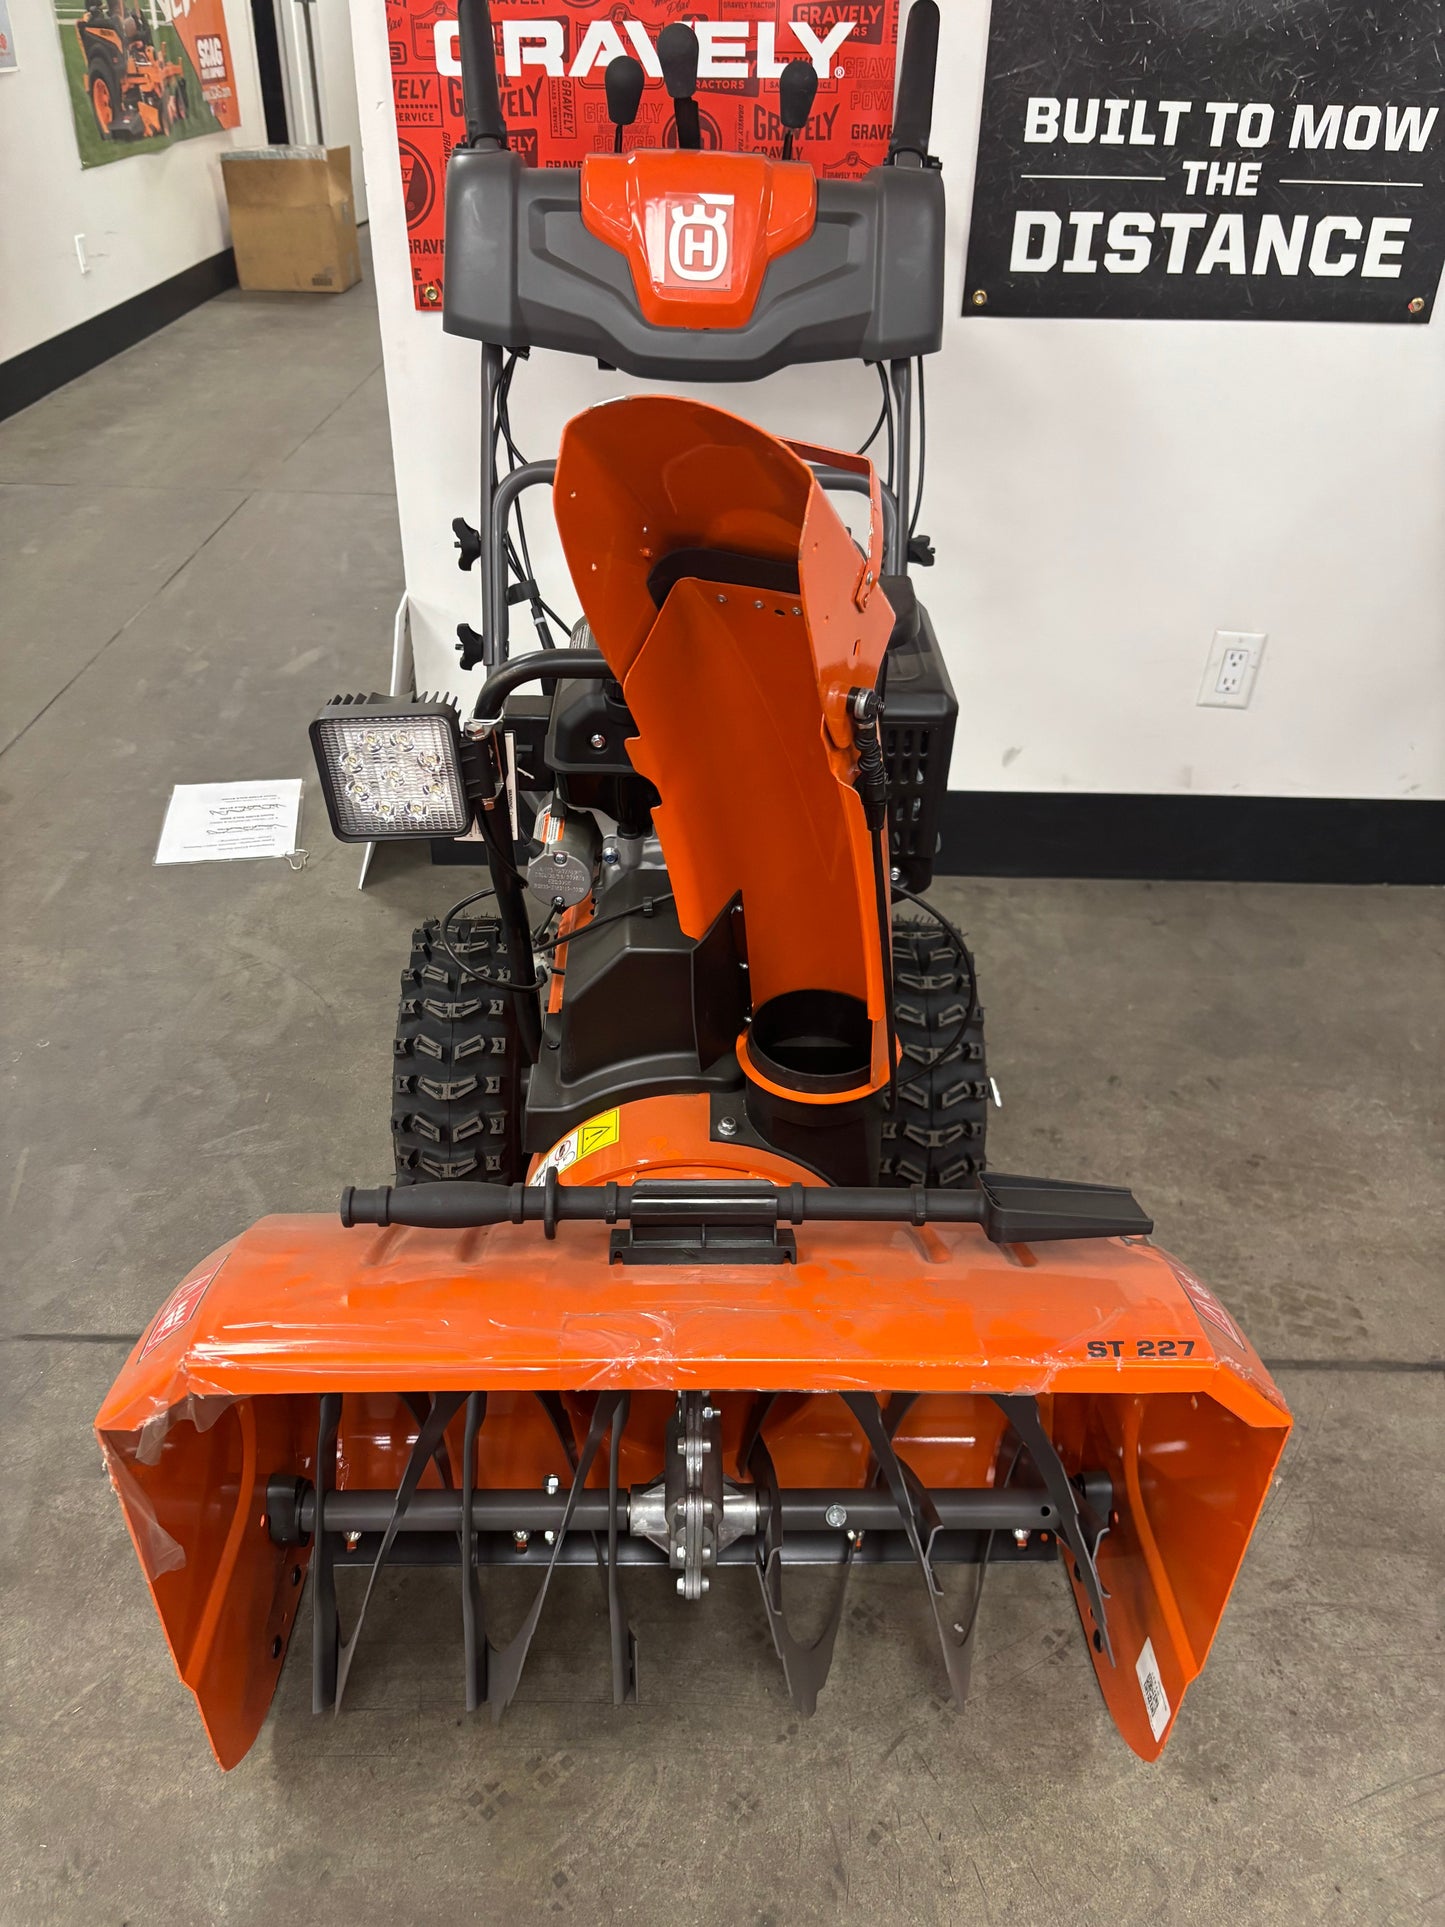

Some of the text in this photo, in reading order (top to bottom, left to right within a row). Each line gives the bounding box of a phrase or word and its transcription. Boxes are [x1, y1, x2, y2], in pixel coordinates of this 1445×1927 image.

[797, 5, 882, 25] GRAVELY
[696, 80, 745, 89] RACTORS
[562, 80, 574, 133] GRAVELY
[754, 104, 840, 141] GRELY
[1023, 97, 1439, 152] BUILT TO MOW
[1182, 161, 1262, 196] THE
[1010, 210, 1412, 278] DISTANCE
[1086, 1340, 1195, 1358] ST 227
